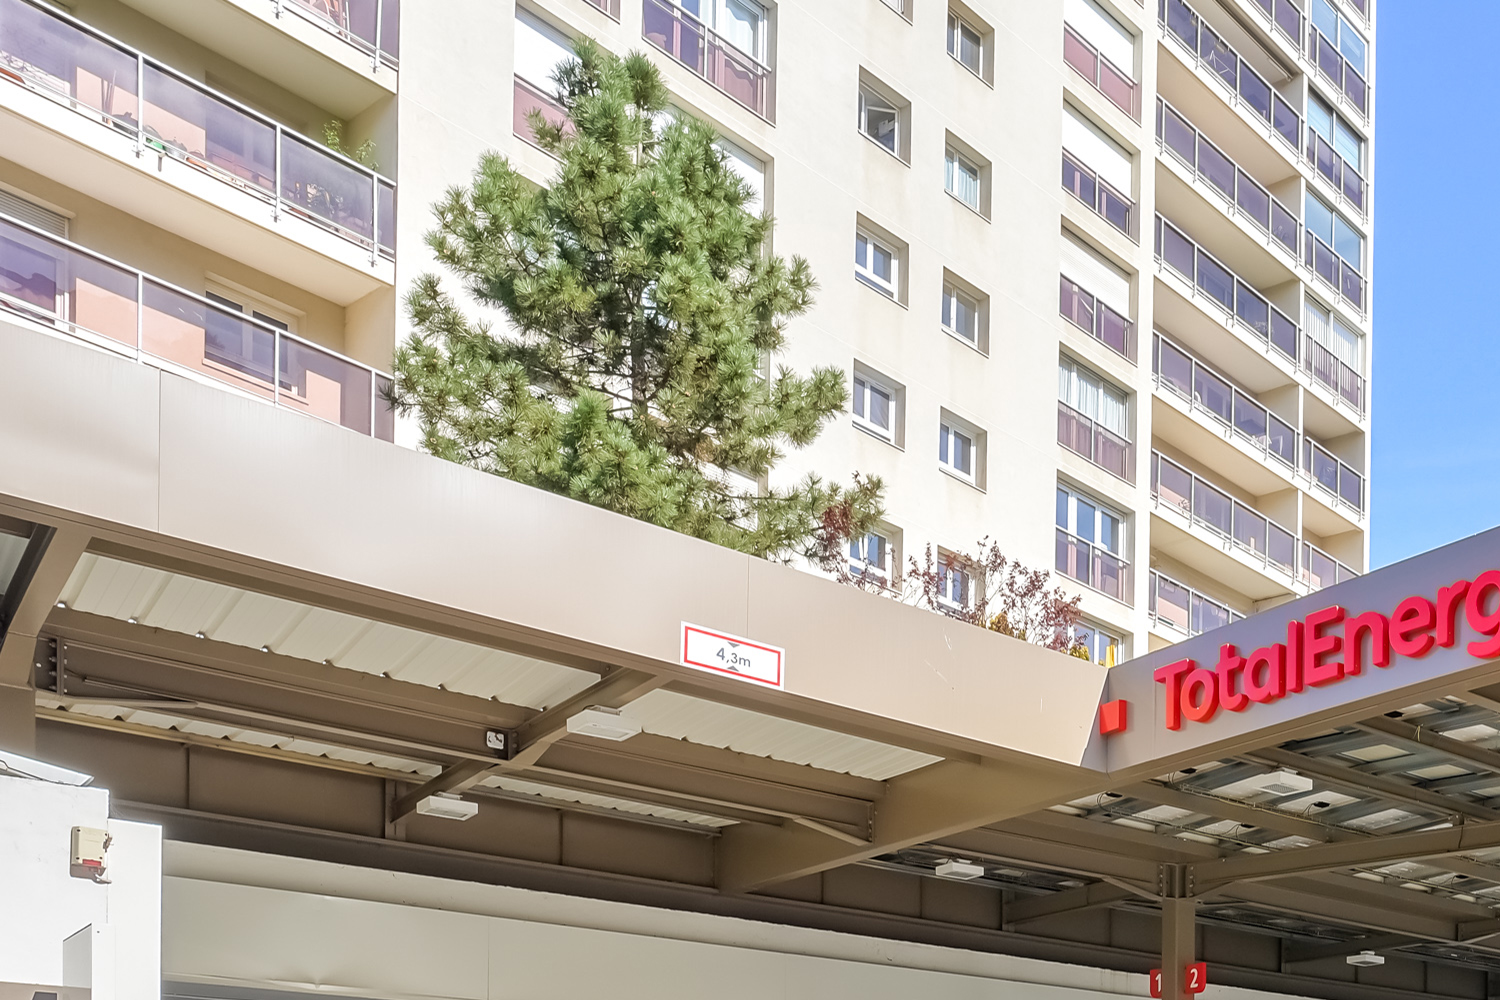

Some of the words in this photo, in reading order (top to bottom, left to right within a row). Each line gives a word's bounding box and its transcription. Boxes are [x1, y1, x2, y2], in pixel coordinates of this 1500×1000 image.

[716, 647, 751, 668] 4,3m
[1155, 973, 1162, 992] 1
[1190, 968, 1199, 988] 2
